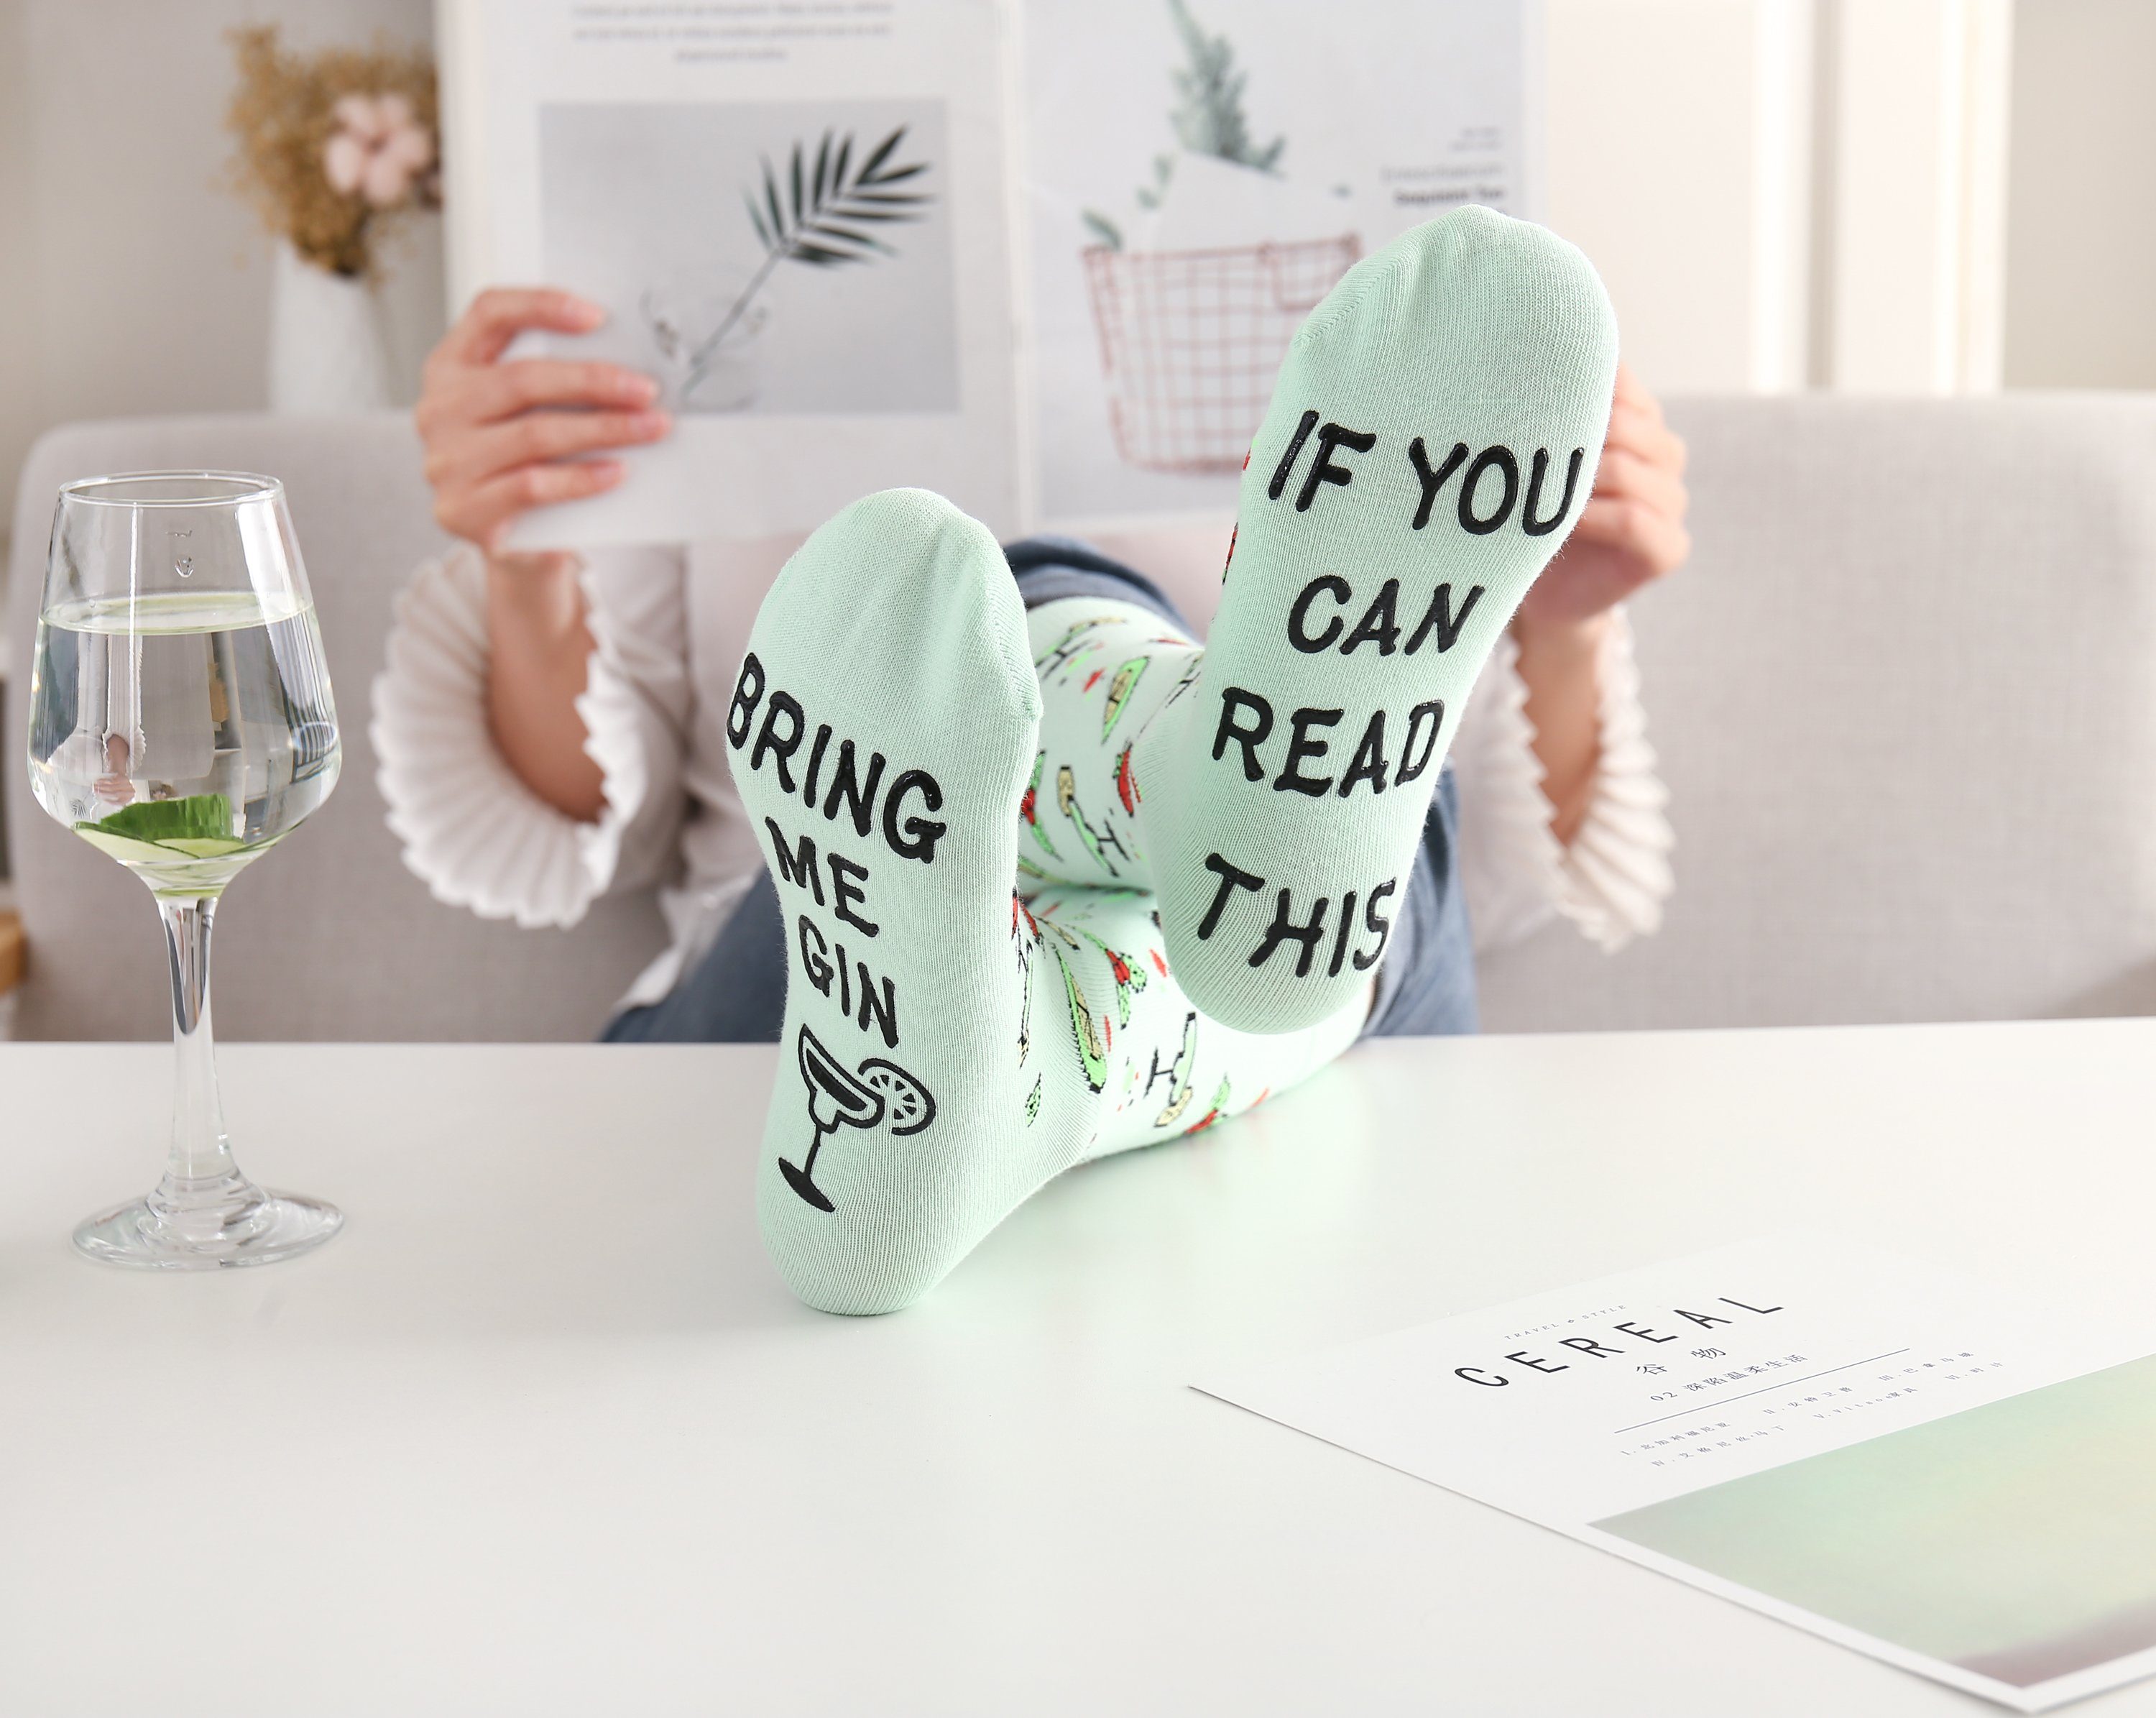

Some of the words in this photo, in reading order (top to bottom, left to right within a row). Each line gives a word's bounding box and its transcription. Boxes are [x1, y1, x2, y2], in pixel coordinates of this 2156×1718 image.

[1268, 410, 1377, 513] IF
[1408, 436, 1585, 537] YOU
[1287, 574, 1485, 657] CAN
[726, 652, 947, 865] BRING
[1212, 686, 1445, 799] READ
[765, 816, 880, 938] ME
[1197, 853, 1396, 978] THIS
[798, 914, 899, 1049] GIN
[1454, 1297, 1784, 1388] CEREAL
[1504, 1322, 1560, 1341] TRAVEL
[1581, 1304, 1626, 1320] STYLE
[1650, 1392, 1678, 1402] 02
[1682, 1354, 1808, 1392] 深陷温柔生活
